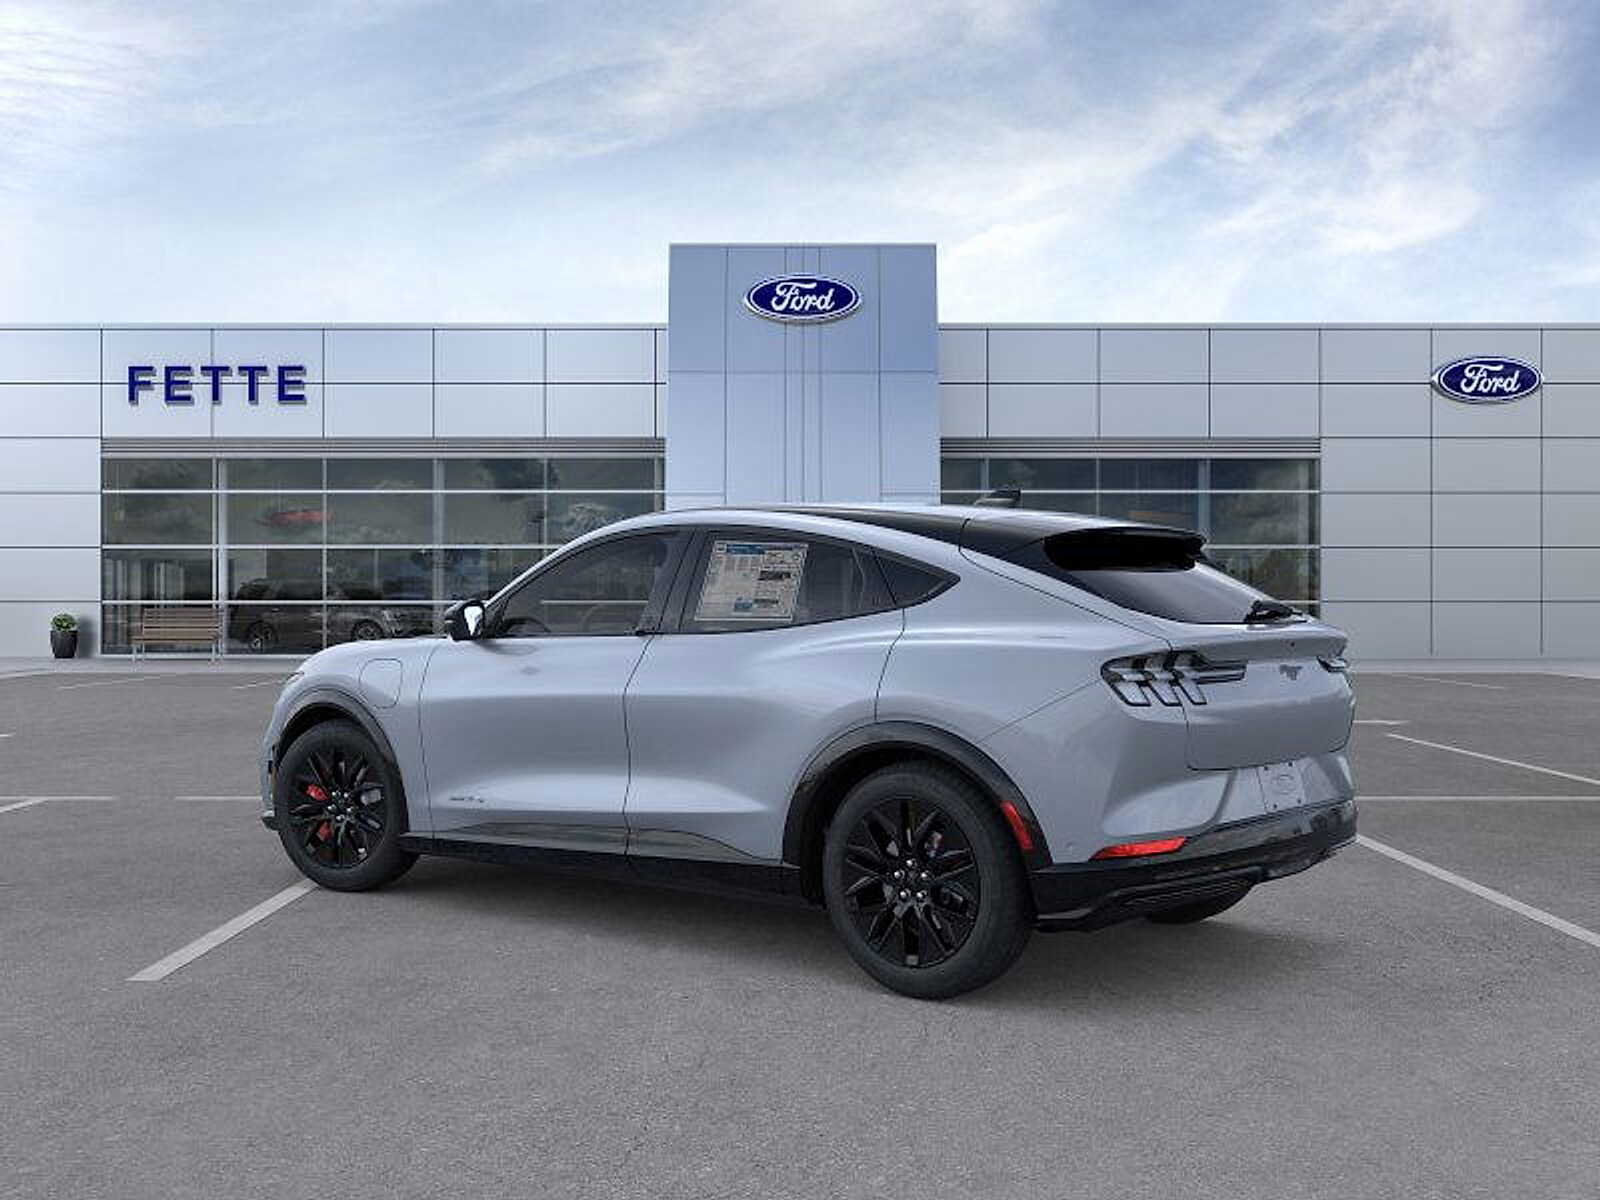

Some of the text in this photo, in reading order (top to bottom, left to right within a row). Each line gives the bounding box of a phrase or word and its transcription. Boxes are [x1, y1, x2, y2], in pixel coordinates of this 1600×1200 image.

[771, 282, 835, 311] Ford
[128, 365, 306, 404] FETTE
[1460, 364, 1521, 393] Ford
